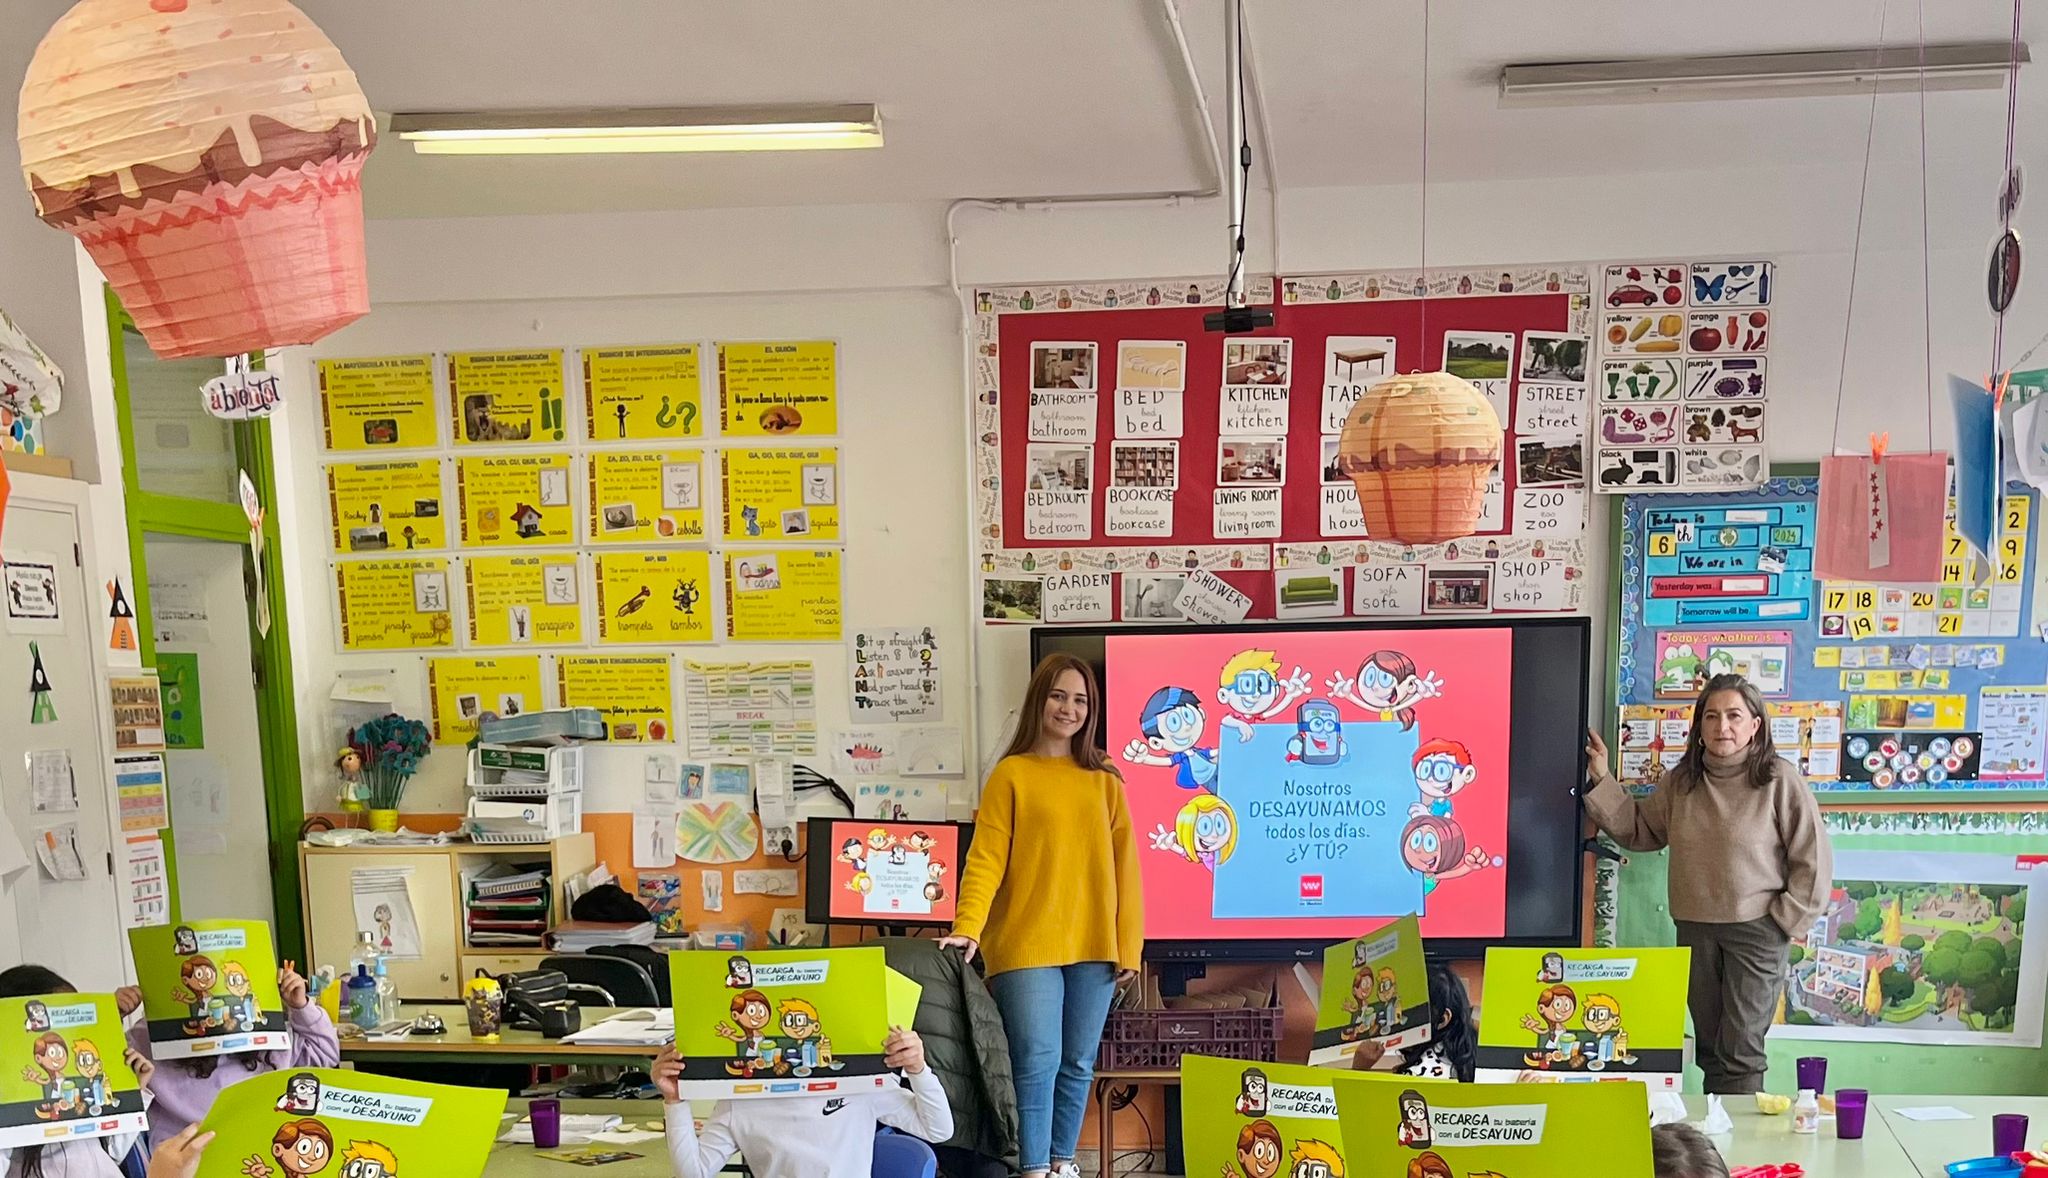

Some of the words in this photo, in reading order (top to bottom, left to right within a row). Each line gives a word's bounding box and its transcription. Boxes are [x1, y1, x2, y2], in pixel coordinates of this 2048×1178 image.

[1608, 268, 1622, 276] red
[1693, 266, 1710, 274] blue
[1606, 315, 1632, 324] yellow
[1690, 314, 1719, 322] orange
[1604, 362, 1628, 370] green
[1688, 360, 1714, 370] purple
[1031, 393, 1087, 407] BATHROOM
[1124, 390, 1164, 406] BED
[1228, 388, 1288, 402] KITCHEN
[1526, 386, 1586, 402] STREET
[1602, 407, 1618, 416] pink
[1686, 406, 1711, 414] brown
[1032, 420, 1087, 436] bathroom
[1127, 416, 1166, 433] bed
[1227, 414, 1284, 428] kitchen
[1528, 414, 1578, 428] street
[1602, 450, 1622, 458] black
[1028, 492, 1088, 506] BEDROOM
[1110, 490, 1174, 502] BOOKCASE
[1215, 490, 1247, 506] LIVING
[1252, 490, 1279, 501] ROOM
[1523, 492, 1564, 509] ZOO
[1110, 516, 1166, 530] bookcase
[1329, 515, 1365, 530] hous
[1525, 518, 1558, 530] zoo
[1694, 513, 1704, 524] is
[2008, 512, 2020, 528] 2
[1030, 520, 1086, 534] bedroom
[1218, 518, 1249, 535] living
[1251, 520, 1276, 529] room
[1658, 536, 1669, 554] 6
[1677, 524, 1692, 542] th
[1950, 538, 1961, 555] 7
[2006, 540, 2016, 556] 9
[1502, 560, 1550, 577] SHOP
[1684, 556, 1704, 568] We
[1707, 558, 1726, 568] are
[1730, 556, 1744, 567] in
[1363, 567, 1408, 582] SOFA
[1943, 564, 1960, 582] 14
[2000, 563, 2017, 580] 16
[1047, 573, 1110, 591] GARDEN
[1192, 569, 1244, 608] SHOWER
[1656, 582, 1694, 592] Yesterday
[1363, 598, 1400, 610] sofa
[1503, 591, 1542, 604] shop
[1828, 592, 1846, 608] 17
[1856, 592, 1872, 608] 18
[1912, 592, 1933, 607] 20
[1052, 600, 1101, 618] garden
[1682, 607, 1722, 616] Tomorrow
[1853, 618, 1872, 635] 19
[1938, 618, 1958, 634] 21
[857, 634, 873, 648] Sit
[876, 639, 886, 650] up
[890, 636, 922, 651] straight
[1666, 632, 1708, 644] Today's
[1711, 632, 1760, 643] weather
[856, 649, 889, 664] Listen
[855, 664, 875, 678] Ask
[887, 668, 916, 676] answer
[856, 680, 878, 693] Nod
[879, 684, 898, 694] your
[900, 679, 922, 690] head
[894, 694, 908, 706] the
[736, 712, 765, 720] BREAK
[890, 708, 926, 722] speaker
[1283, 780, 1352, 796] Nosotros
[1250, 800, 1386, 818] DESAYUNAMOS
[1265, 823, 1306, 839] todos
[1309, 822, 1330, 838] los
[1334, 822, 1370, 838] días.
[1286, 843, 1310, 864] ¿Y
[1314, 840, 1349, 860] TÚ?
[782, 914, 798, 924] YES
[756, 966, 794, 975] RECARGA
[1584, 970, 1628, 978] DESAYUNO
[776, 974, 821, 983] DESAYUNO
[324, 1090, 382, 1108] RECARGA
[1271, 1088, 1322, 1102] RECARGA
[826, 1098, 845, 1108] NIKE
[1295, 1102, 1338, 1116] DESAYU
[326, 1105, 342, 1114] con
[352, 1106, 417, 1124] DESAYUNO
[1434, 1112, 1490, 1127] RECARGA
[1493, 1118, 1503, 1126] tu
[1505, 1117, 1536, 1126] batería
[1462, 1128, 1533, 1141] DESAYUNO
